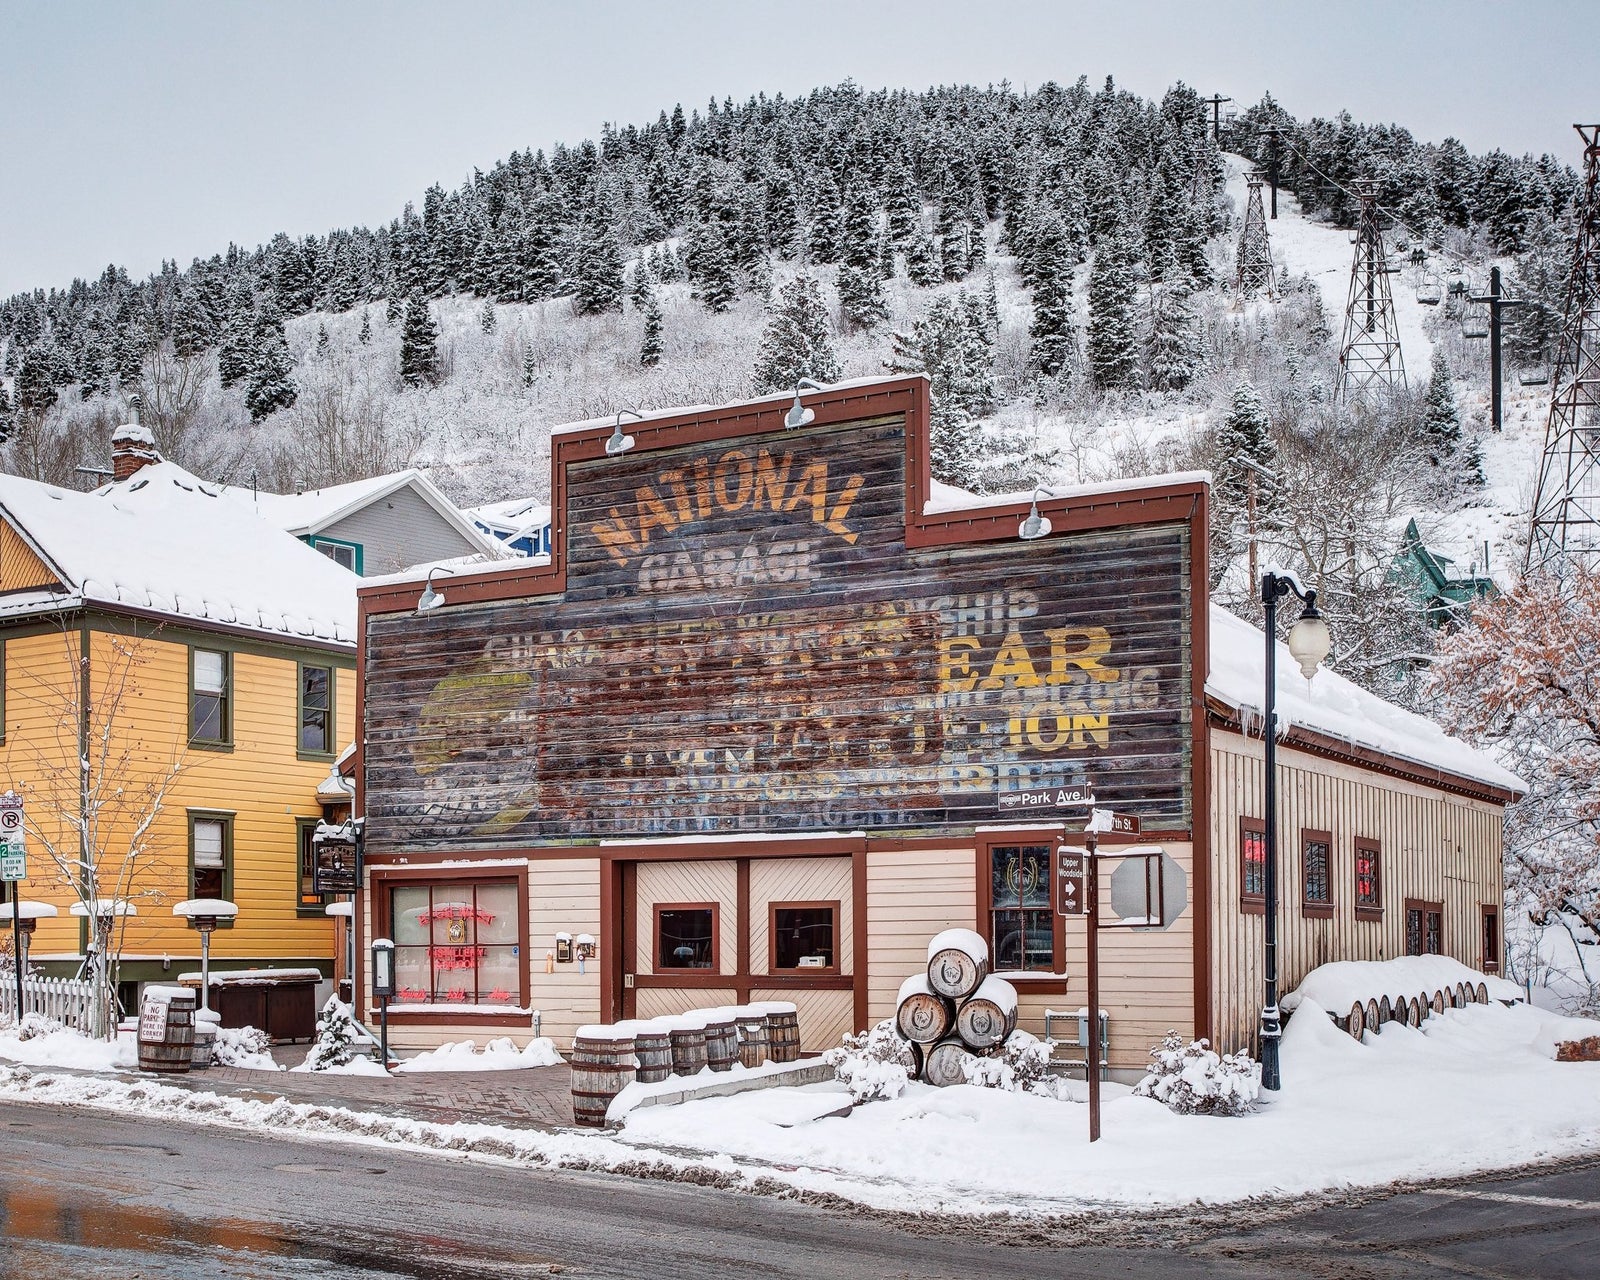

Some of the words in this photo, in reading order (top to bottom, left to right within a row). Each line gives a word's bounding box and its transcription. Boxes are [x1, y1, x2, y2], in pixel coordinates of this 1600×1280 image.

[590, 449, 866, 567] NATIONAL
[638, 540, 822, 592] GARAGE
[1021, 791, 1051, 805] Park
[1057, 789, 1084, 802] Ave.
[1062, 857, 1079, 868] Upper
[1058, 868, 1083, 878] Woodside
